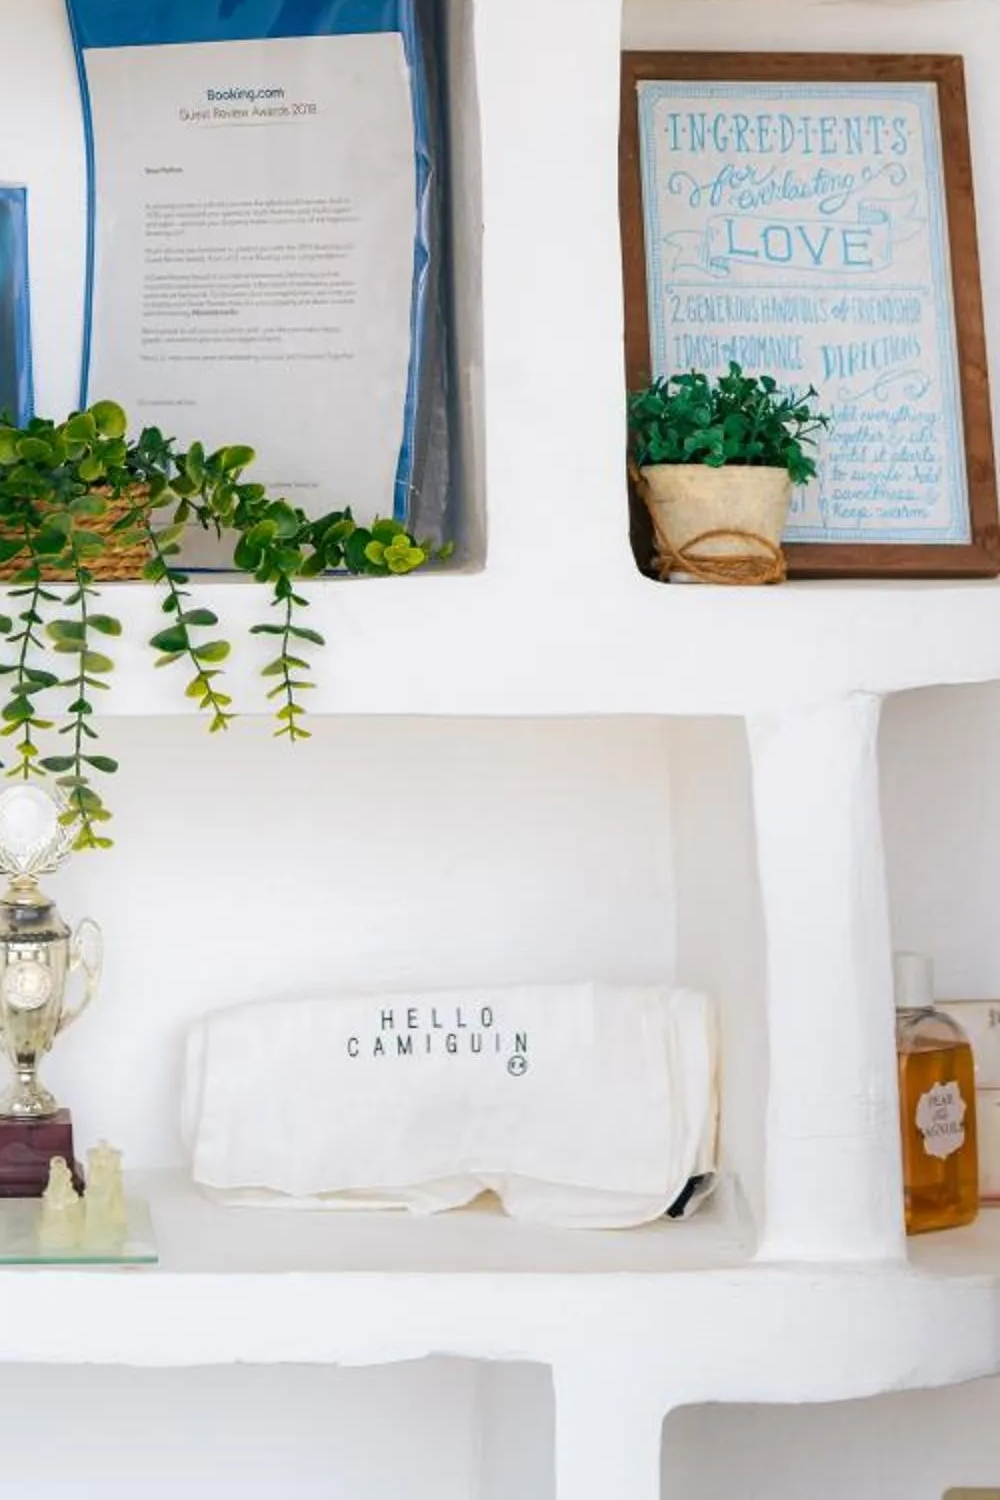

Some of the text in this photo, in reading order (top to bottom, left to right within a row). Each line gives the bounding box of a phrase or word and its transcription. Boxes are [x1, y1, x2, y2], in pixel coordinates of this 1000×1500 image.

[207, 87, 285, 102] Booking.com
[668, 112, 909, 156] INGREDIENTS
[724, 217, 875, 267] LOVE
[381, 1006, 493, 1030] HELLO
[347, 1032, 527, 1058] CAMIGUIN
